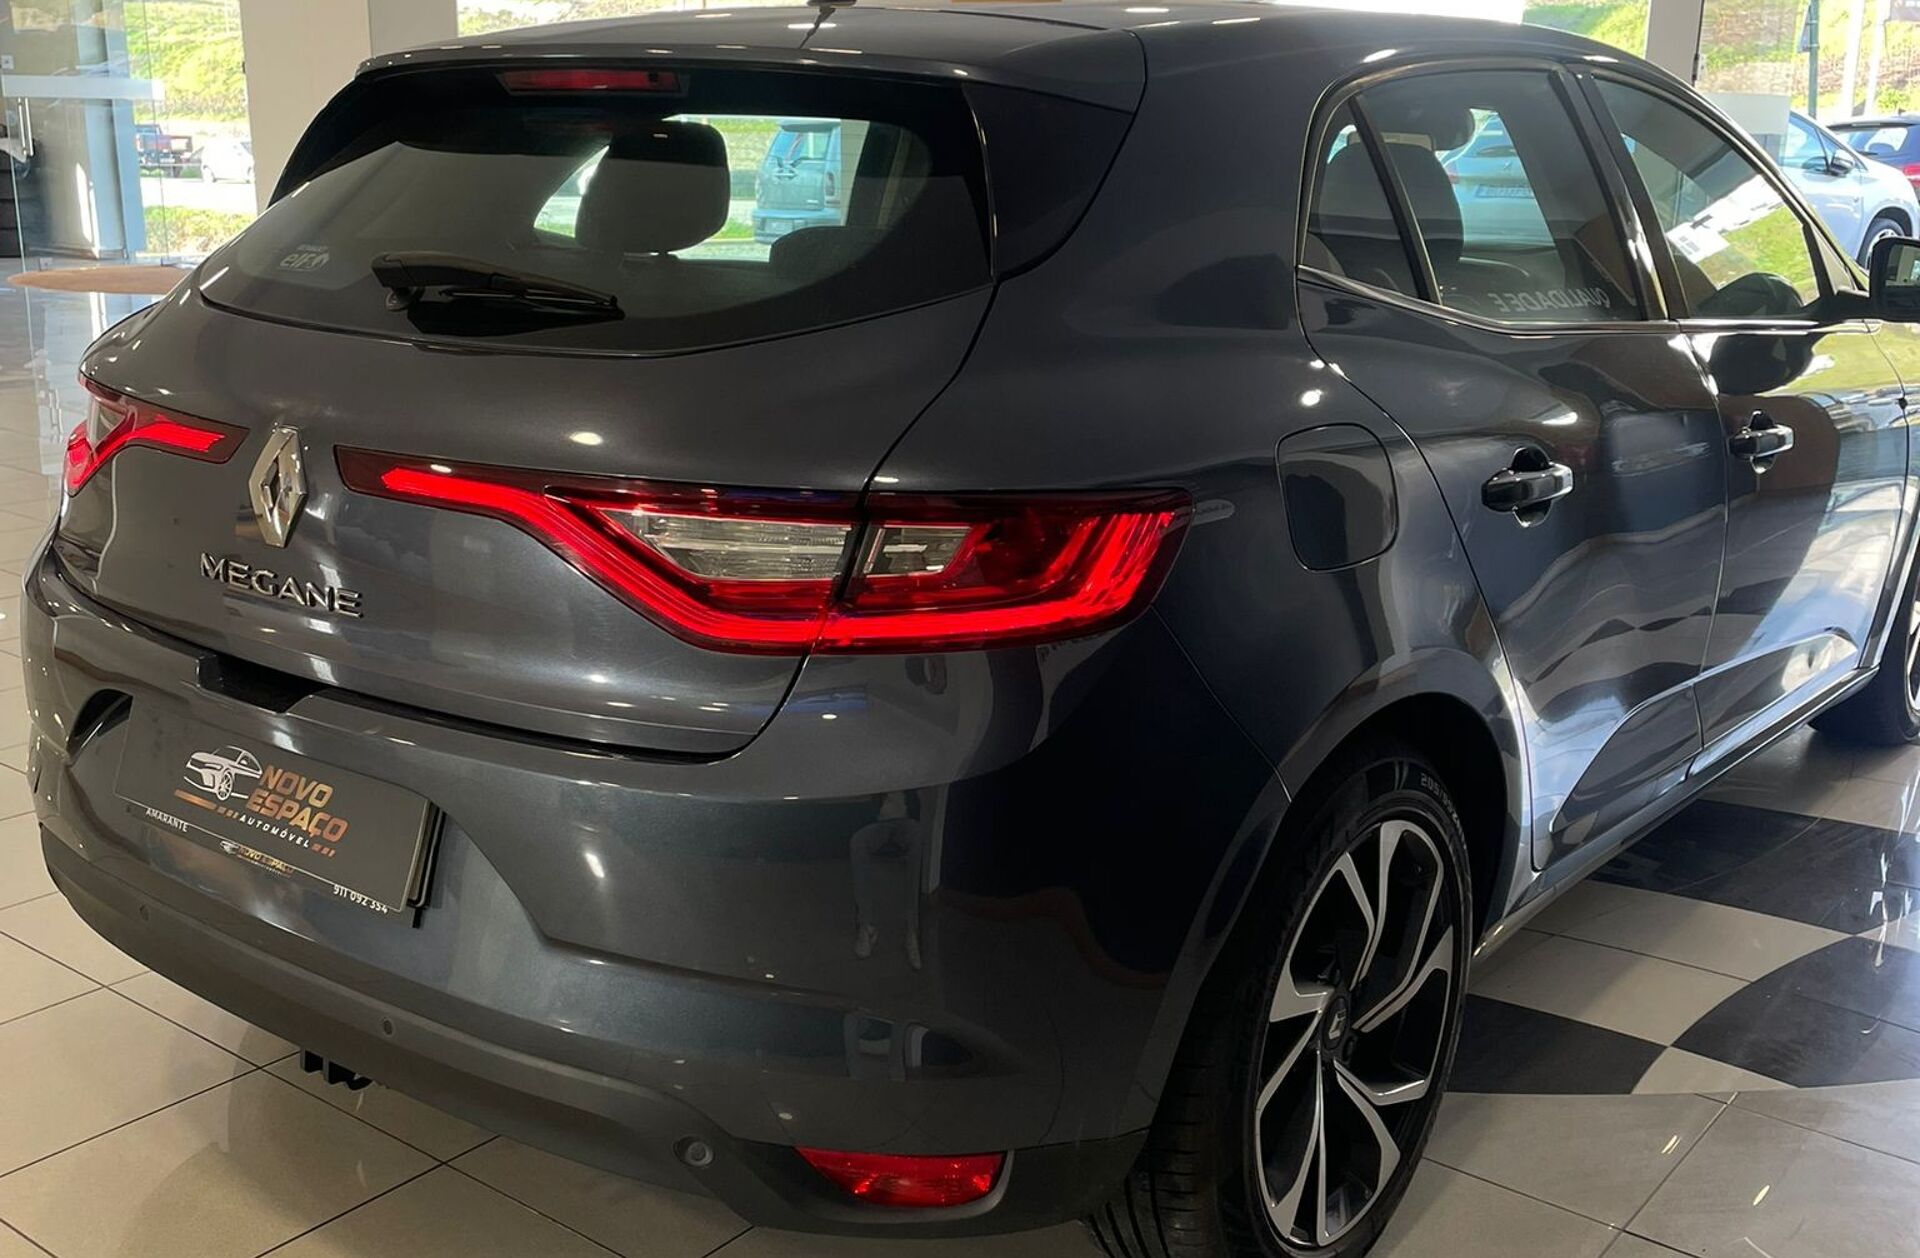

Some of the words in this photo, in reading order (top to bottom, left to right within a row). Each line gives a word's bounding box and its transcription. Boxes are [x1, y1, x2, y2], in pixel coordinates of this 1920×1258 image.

[201, 552, 364, 618] MEGANE
[260, 765, 333, 808] NOVO
[145, 807, 187, 832] AMARANTE
[240, 814, 310, 848] AUTOMÓVEL
[246, 788, 348, 842] ESPAÇO
[333, 884, 347, 898] 911
[350, 891, 367, 906] 092
